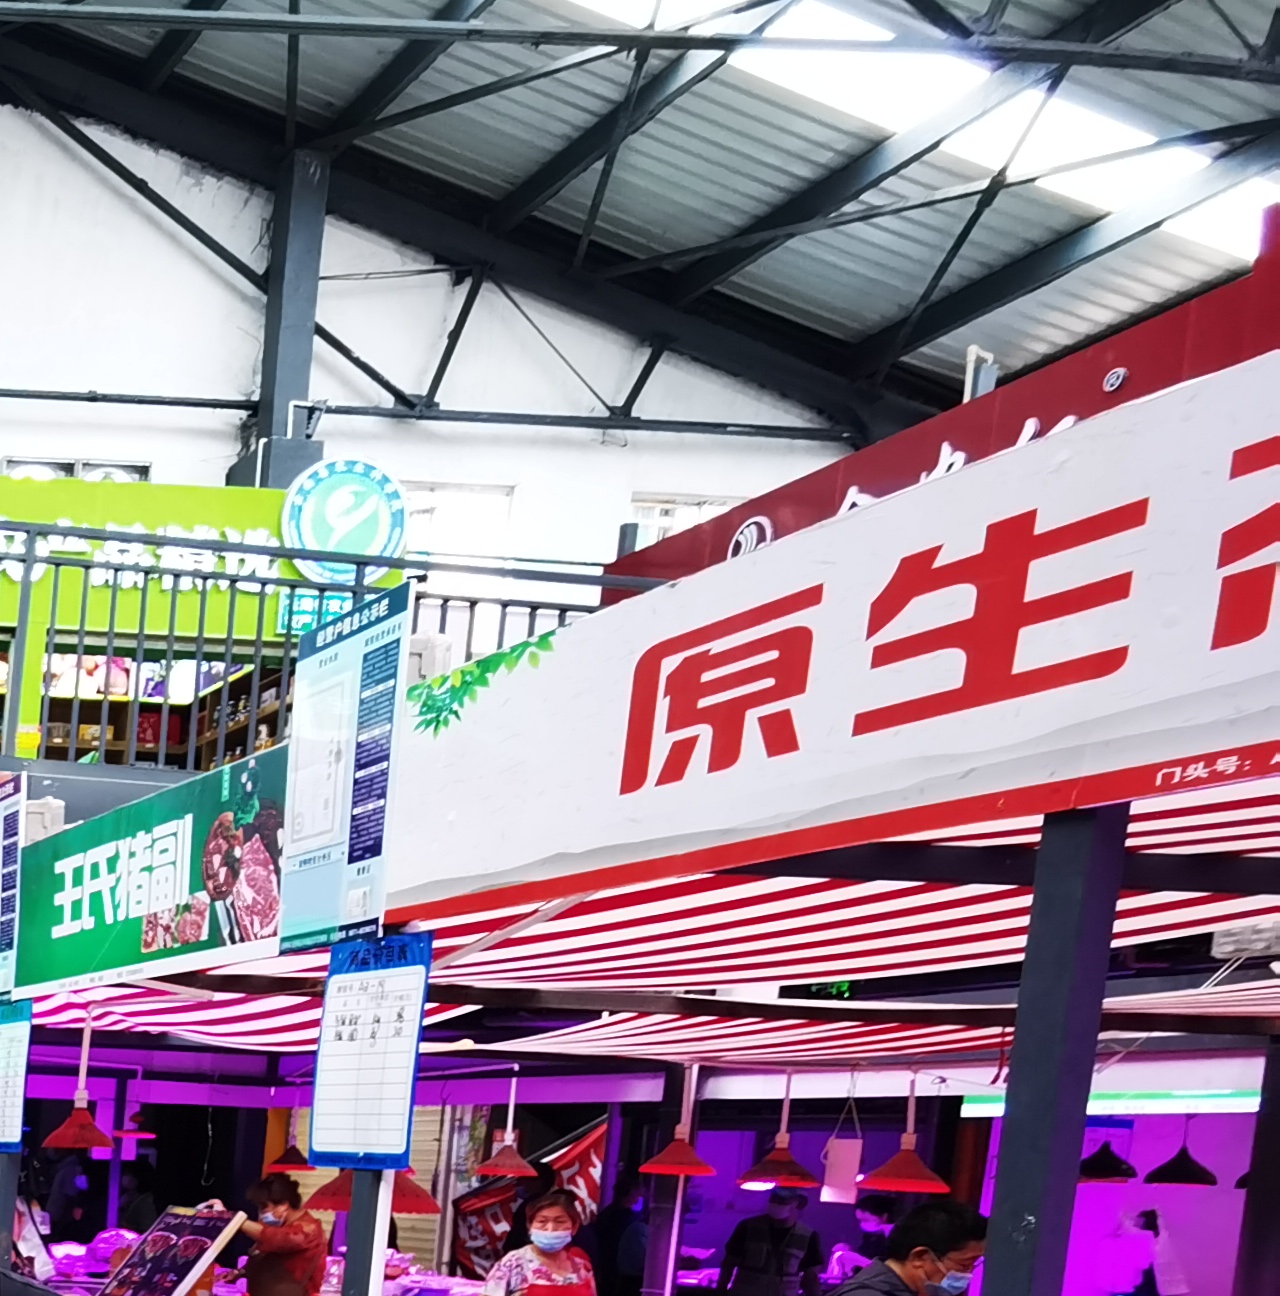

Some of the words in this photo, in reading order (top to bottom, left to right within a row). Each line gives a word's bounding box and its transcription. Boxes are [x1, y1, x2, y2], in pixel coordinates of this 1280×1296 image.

[619, 437, 1280, 797] 原生
[50, 813, 194, 940] 王氏猪副
